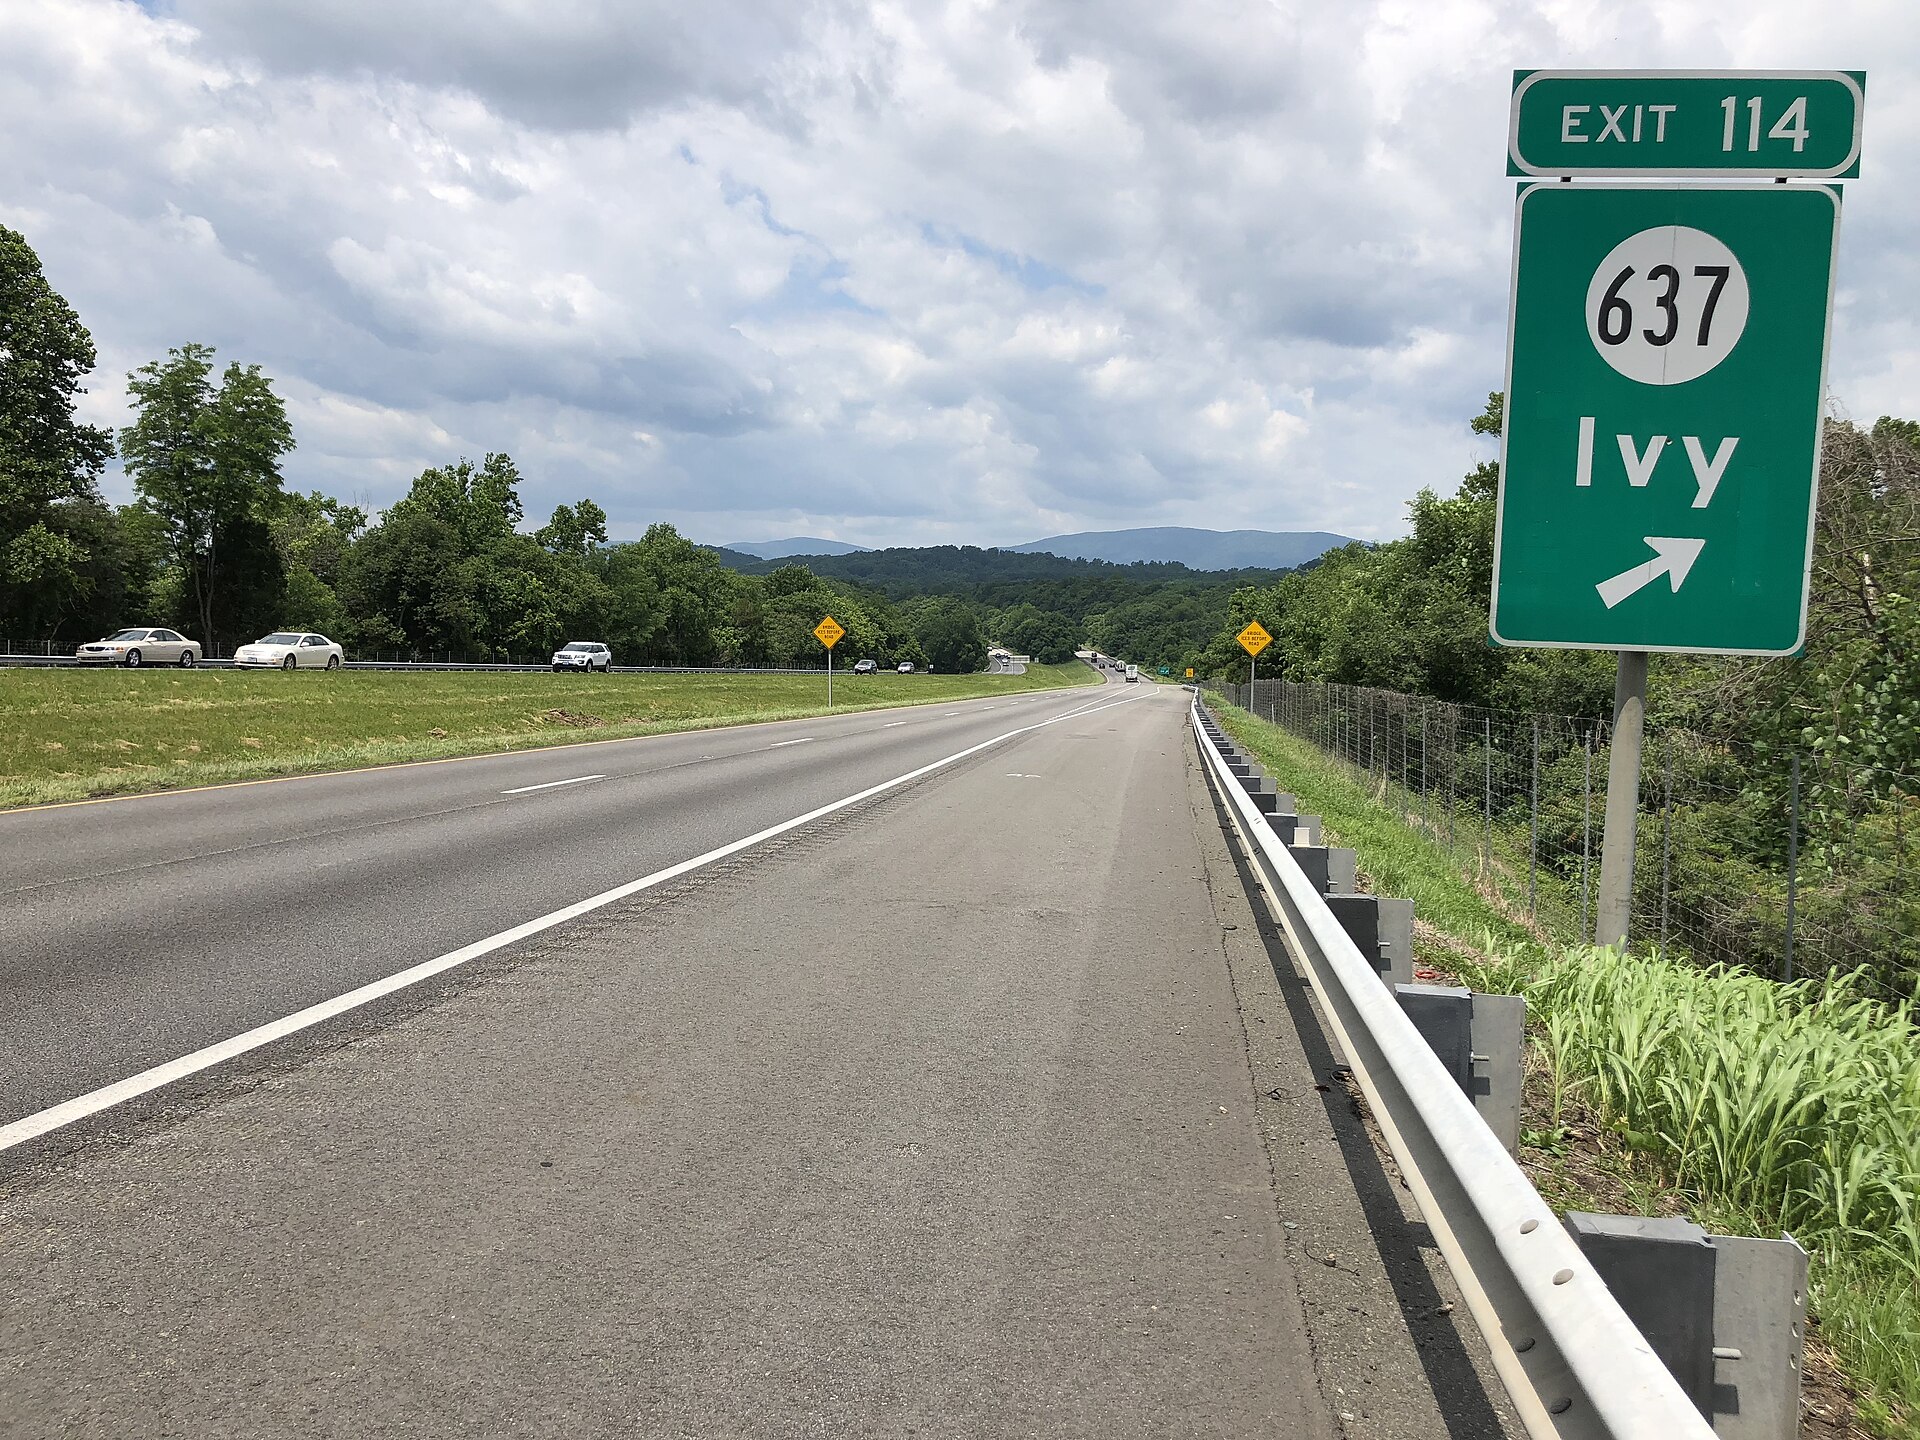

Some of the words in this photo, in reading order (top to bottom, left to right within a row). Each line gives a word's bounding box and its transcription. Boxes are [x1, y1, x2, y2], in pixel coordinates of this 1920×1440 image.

[1561, 104, 1677, 143] EXIT
[1720, 96, 1810, 152] 114
[1597, 264, 1730, 347] 637
[1575, 416, 1740, 509] Ivy
